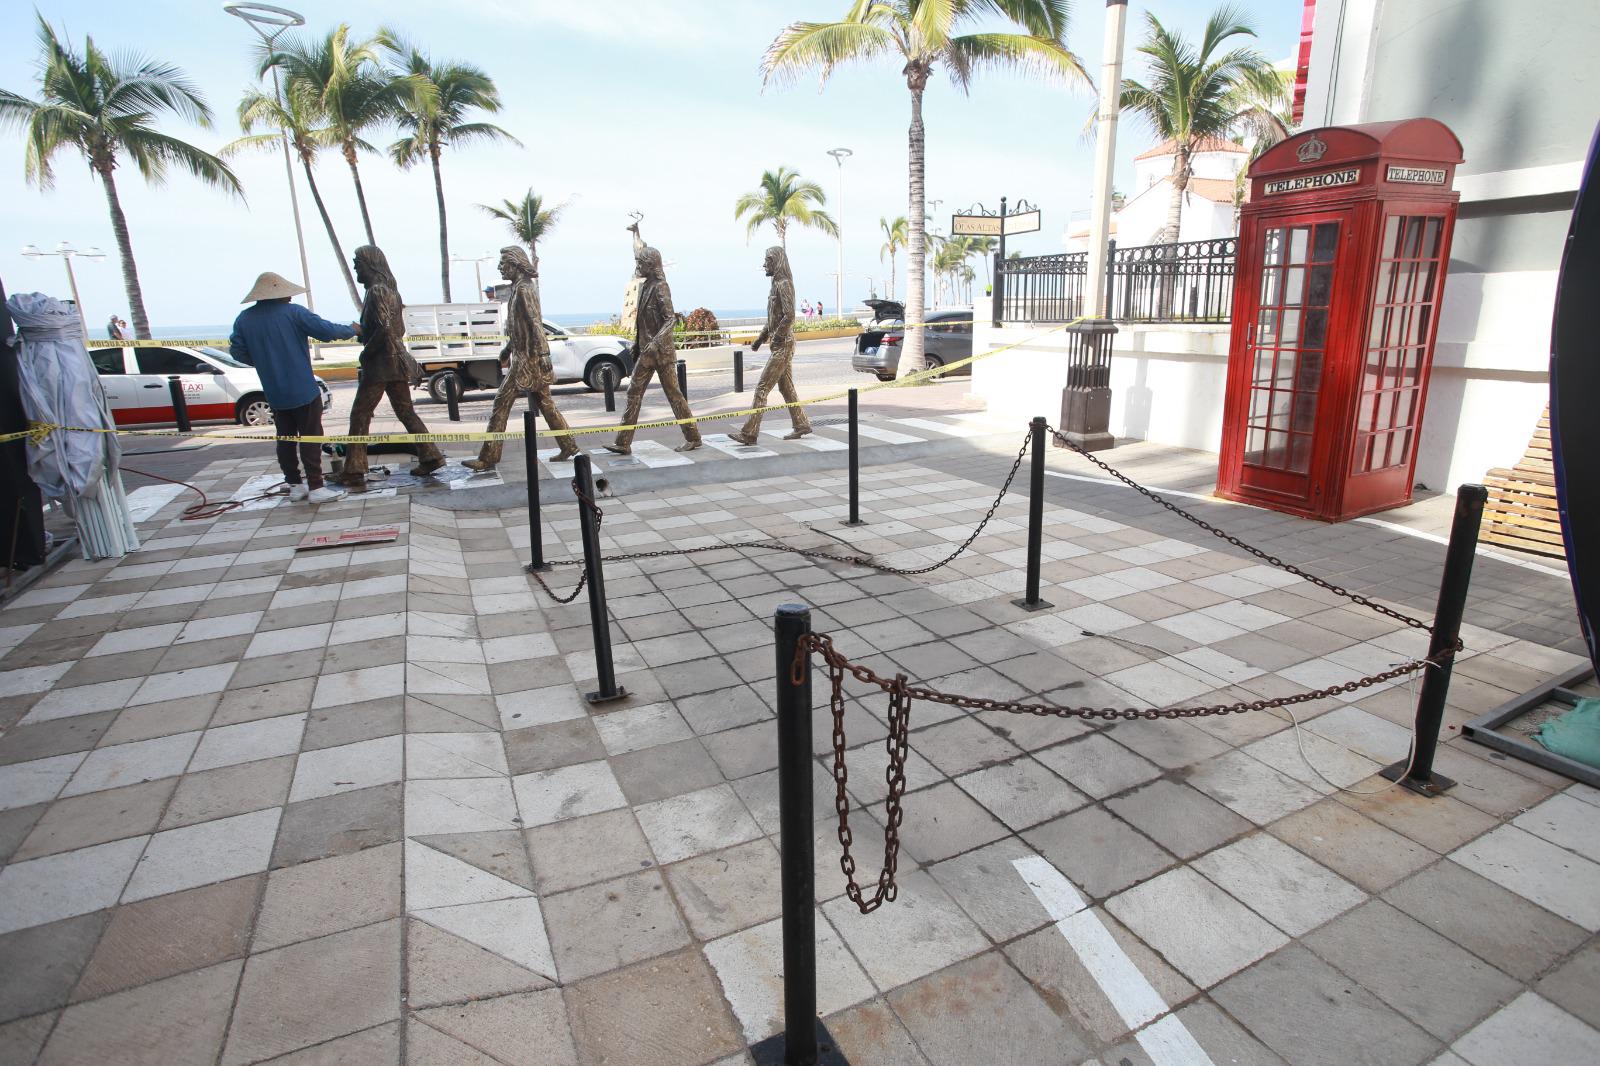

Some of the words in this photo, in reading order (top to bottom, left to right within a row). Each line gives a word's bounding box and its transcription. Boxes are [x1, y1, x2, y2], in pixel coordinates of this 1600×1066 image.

[1267, 169, 1358, 194] TELEPHONE
[1388, 167, 1445, 183] TELEPHONE
[955, 222, 975, 231] OLAS
[976, 223, 1000, 232] ALTAS
[182, 383, 204, 391] TAXI
